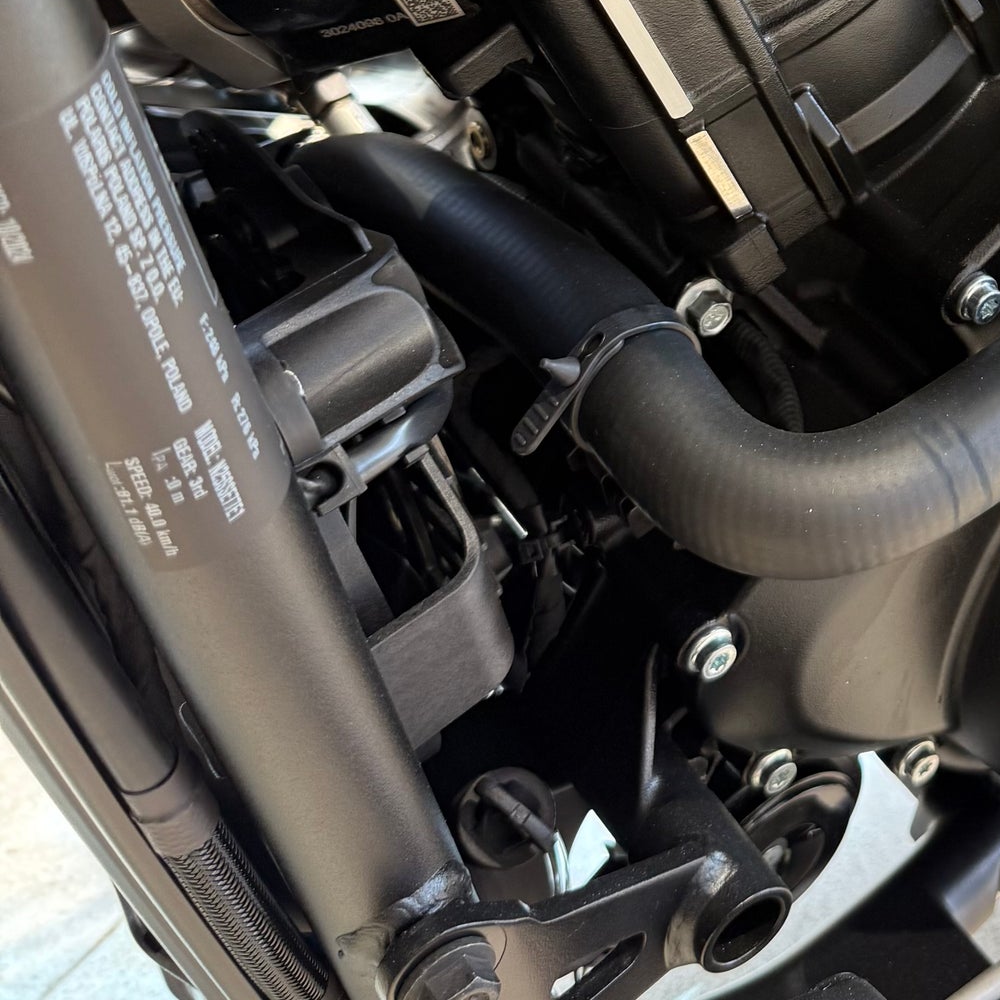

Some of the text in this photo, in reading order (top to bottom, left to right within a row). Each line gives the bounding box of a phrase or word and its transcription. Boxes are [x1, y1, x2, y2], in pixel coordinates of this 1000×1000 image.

[75, 93, 113, 170] POLARIS
[103, 162, 138, 230] POLAND
[128, 226, 147, 257] SP.
[89, 82, 127, 160] CONTACT
[118, 157, 154, 231] ADDRESS
[147, 226, 162, 250] IN
[156, 244, 174, 281] THE
[101, 69, 124, 120] COLD
[118, 114, 156, 200] INFLATION
[151, 195, 187, 276] PRESSURE
[141, 305, 170, 361] OPOLE,
[161, 356, 193, 415] POLAND
[172, 437, 209, 501] GEAR: 3rd
[194, 418, 223, 467] MODEL:
[124, 456, 179, 557] SPEED: 40.0 km/h
